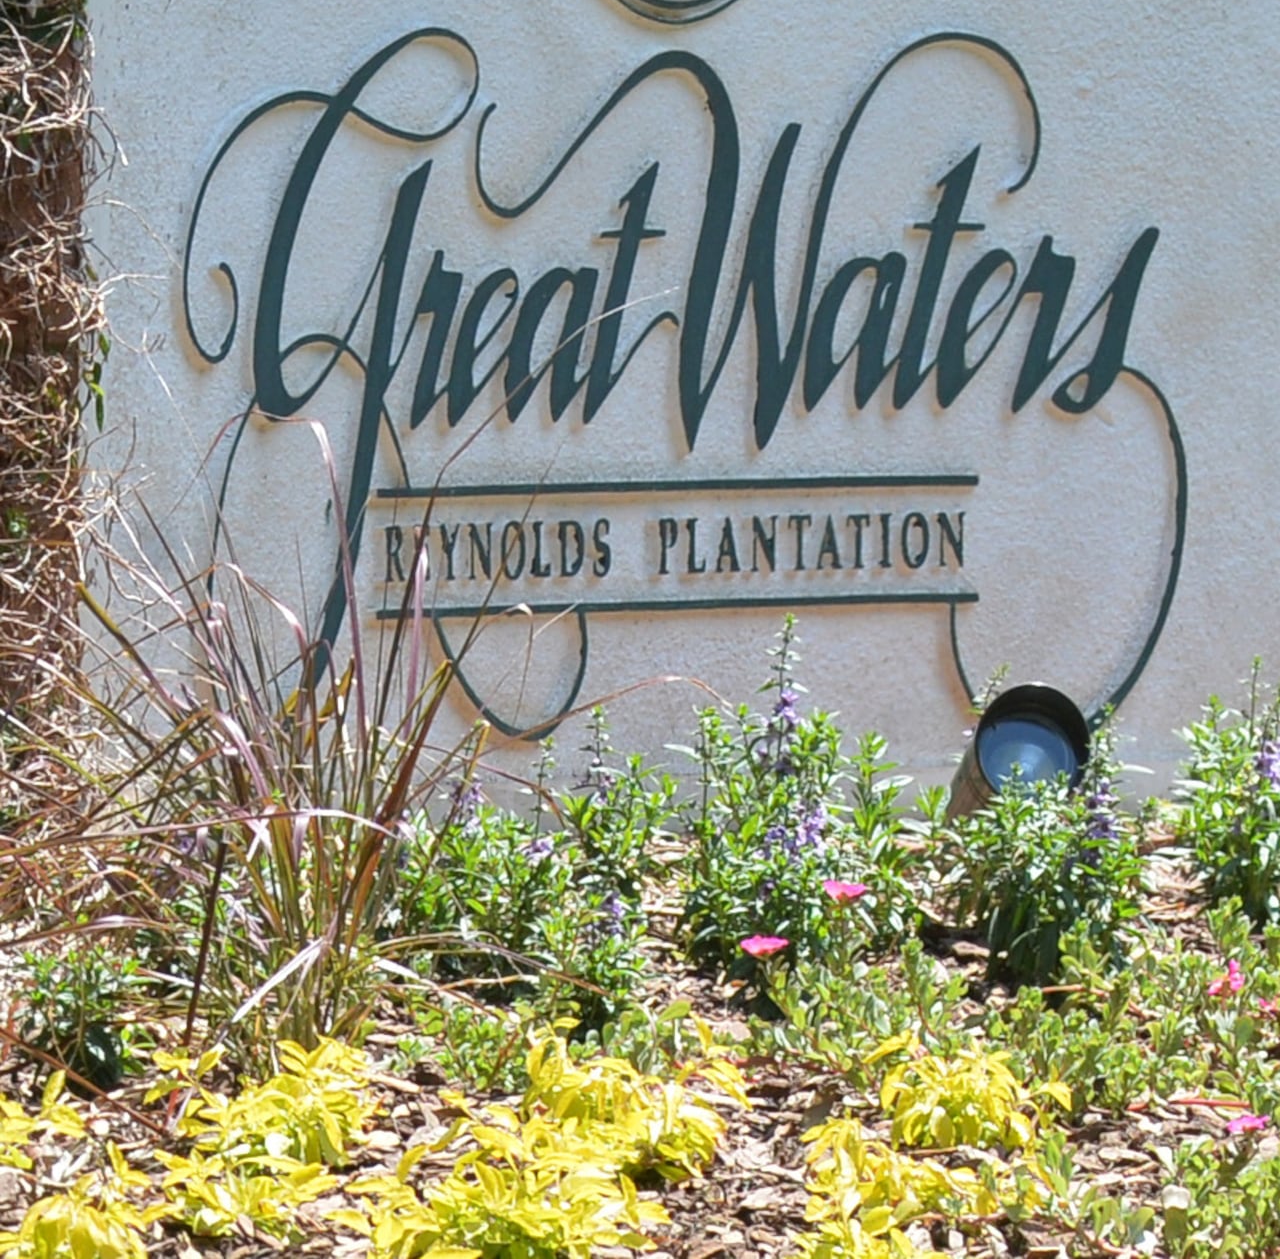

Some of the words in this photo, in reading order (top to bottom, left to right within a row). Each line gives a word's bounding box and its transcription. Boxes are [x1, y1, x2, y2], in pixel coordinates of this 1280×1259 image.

[182, 26, 680, 685] Great
[476, 32, 1160, 452] Waters
[658, 510, 967, 577] PLANTATION
